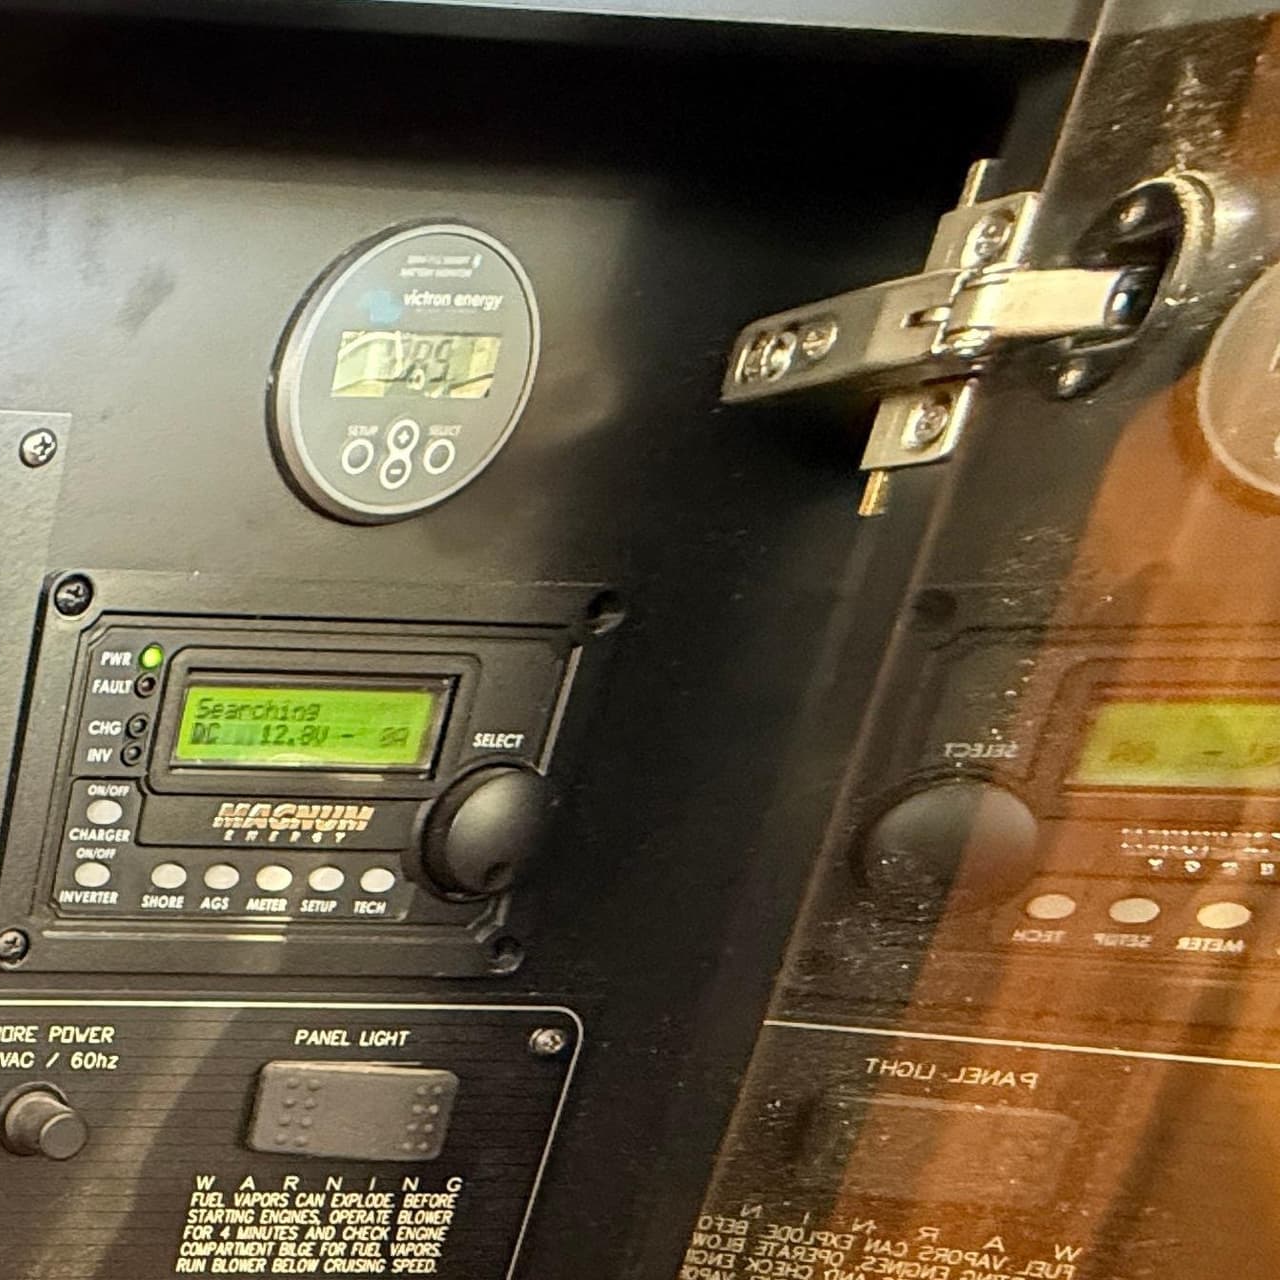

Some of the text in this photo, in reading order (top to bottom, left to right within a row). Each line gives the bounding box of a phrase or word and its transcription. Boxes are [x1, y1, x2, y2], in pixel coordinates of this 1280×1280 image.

[403, 290, 503, 311] victron energy
[101, 651, 131, 667] PWR
[92, 679, 131, 695] FAULT
[196, 698, 321, 720] Searching
[88, 719, 121, 736] CHG
[190, 725, 218, 745] DC
[473, 733, 524, 749] SELECT
[87, 747, 111, 763] INV
[88, 785, 129, 797] ON/OFF
[213, 802, 375, 831] MAGNUM
[69, 828, 130, 843] CHARGER
[224, 830, 345, 843] ENERGY
[59, 890, 119, 905] INVERTER
[142, 894, 184, 910] SHORE
[200, 896, 229, 911] AGS
[48, 1025, 115, 1044] POWER
[295, 1029, 410, 1047] PANEL LIGHT
[46, 1051, 60, 1069] /
[70, 1051, 120, 1069] 60hz
[190, 1193, 225, 1208] FUEL
[233, 1193, 289, 1208] VAPORS
[295, 1193, 325, 1208] CAN
[403, 1193, 459, 1208] BEFORE
[187, 1210, 255, 1224] STARTING
[329, 1210, 392, 1224] OPERATE
[397, 1210, 454, 1224] BLOWER
[183, 1226, 390, 1241] FOR 4 MINUTES AND CHECK
[180, 1242, 275, 1257] COMPARTMENT
[278, 1243, 318, 1257] BILGE
[319, 1243, 347, 1257] FOR
[350, 1243, 383, 1257] FUEL
[176, 1259, 438, 1273] RUN BLOWER BELOW CRUISING SPEED.
